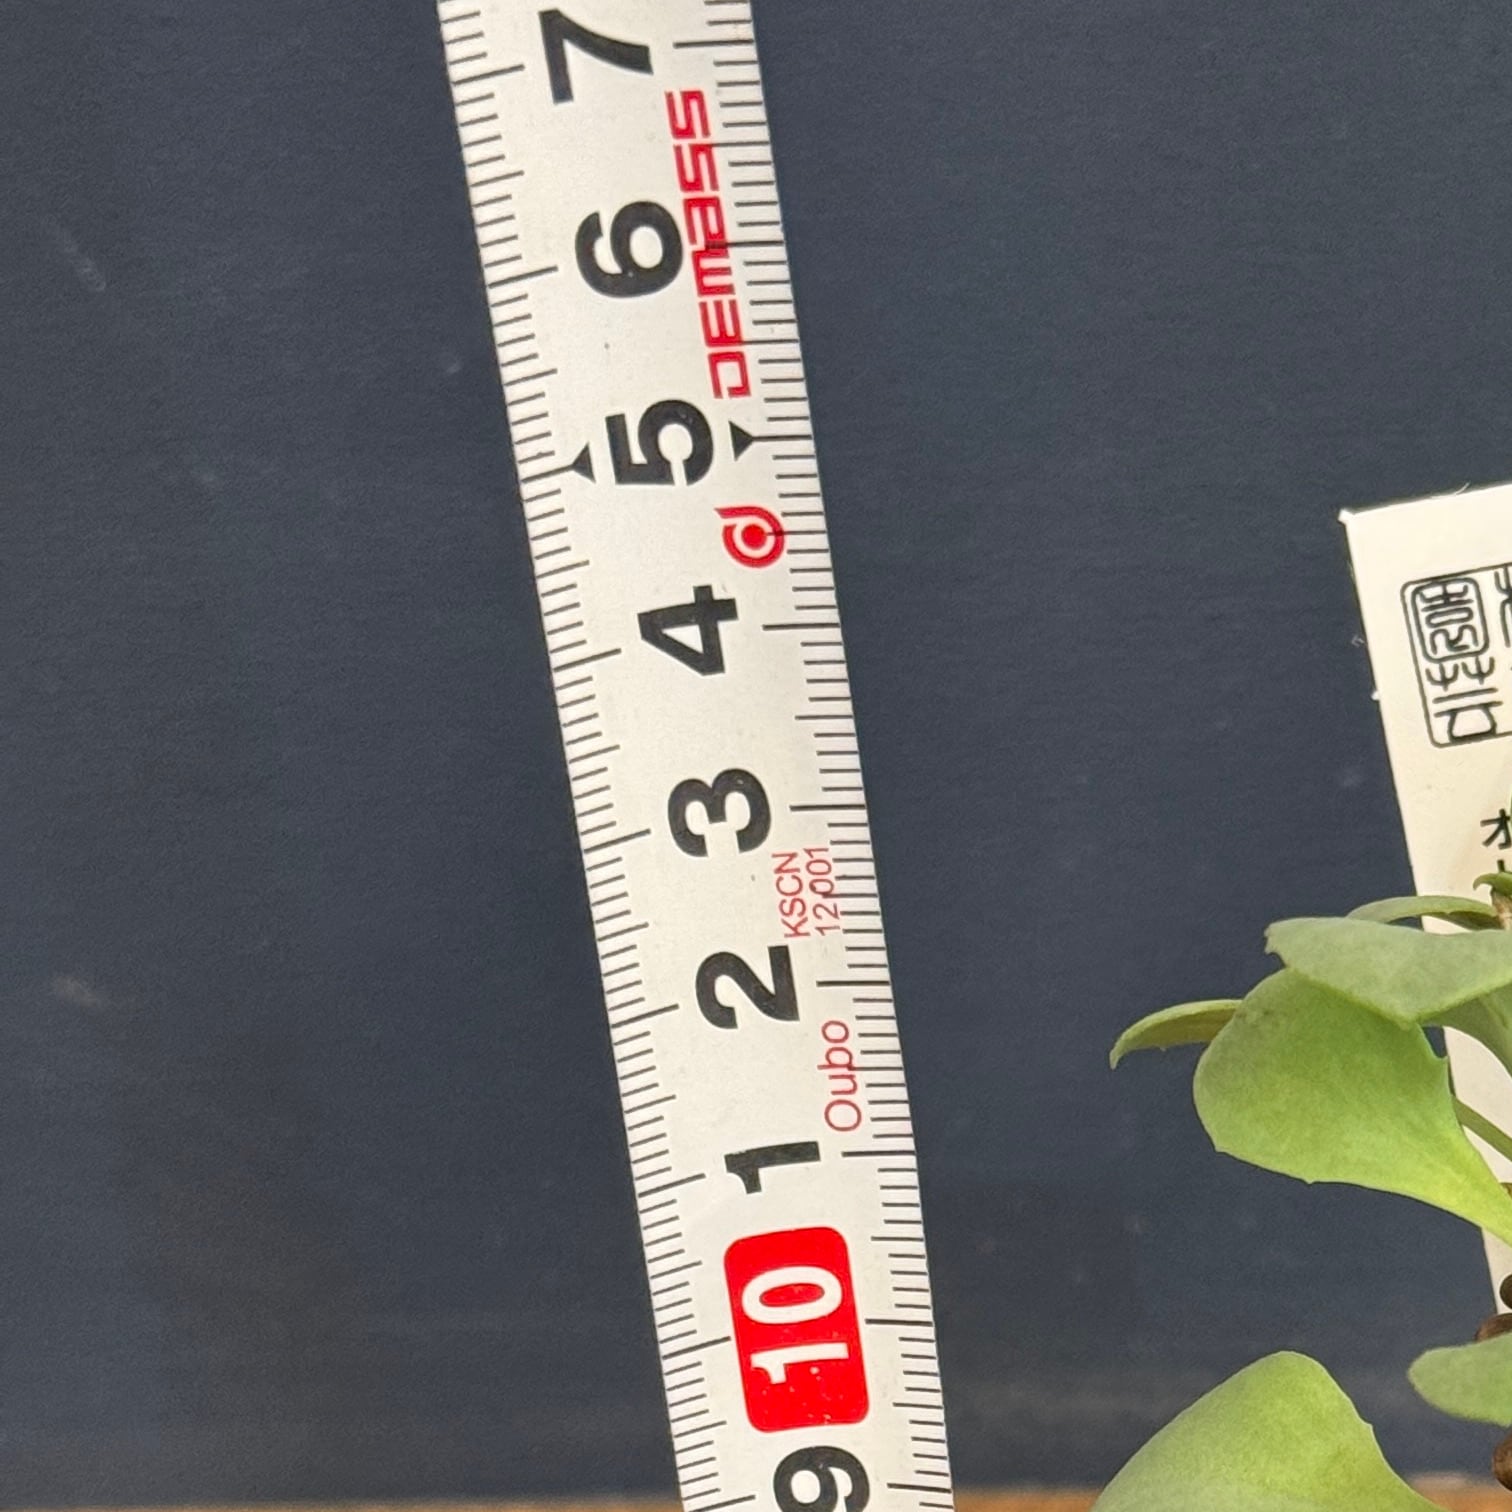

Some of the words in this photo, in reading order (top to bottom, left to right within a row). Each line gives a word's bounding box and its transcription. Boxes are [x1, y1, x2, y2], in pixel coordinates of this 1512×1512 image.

[538, 8, 654, 105] 7
[574, 200, 684, 299] 6
[605, 399, 714, 486] 5
[637, 584, 739, 676] 4
[667, 768, 771, 857] 3
[772, 851, 811, 938] KSCN
[695, 945, 800, 1029] 2
[724, 1141, 821, 1194] 1
[741, 1265, 850, 1385] 10
